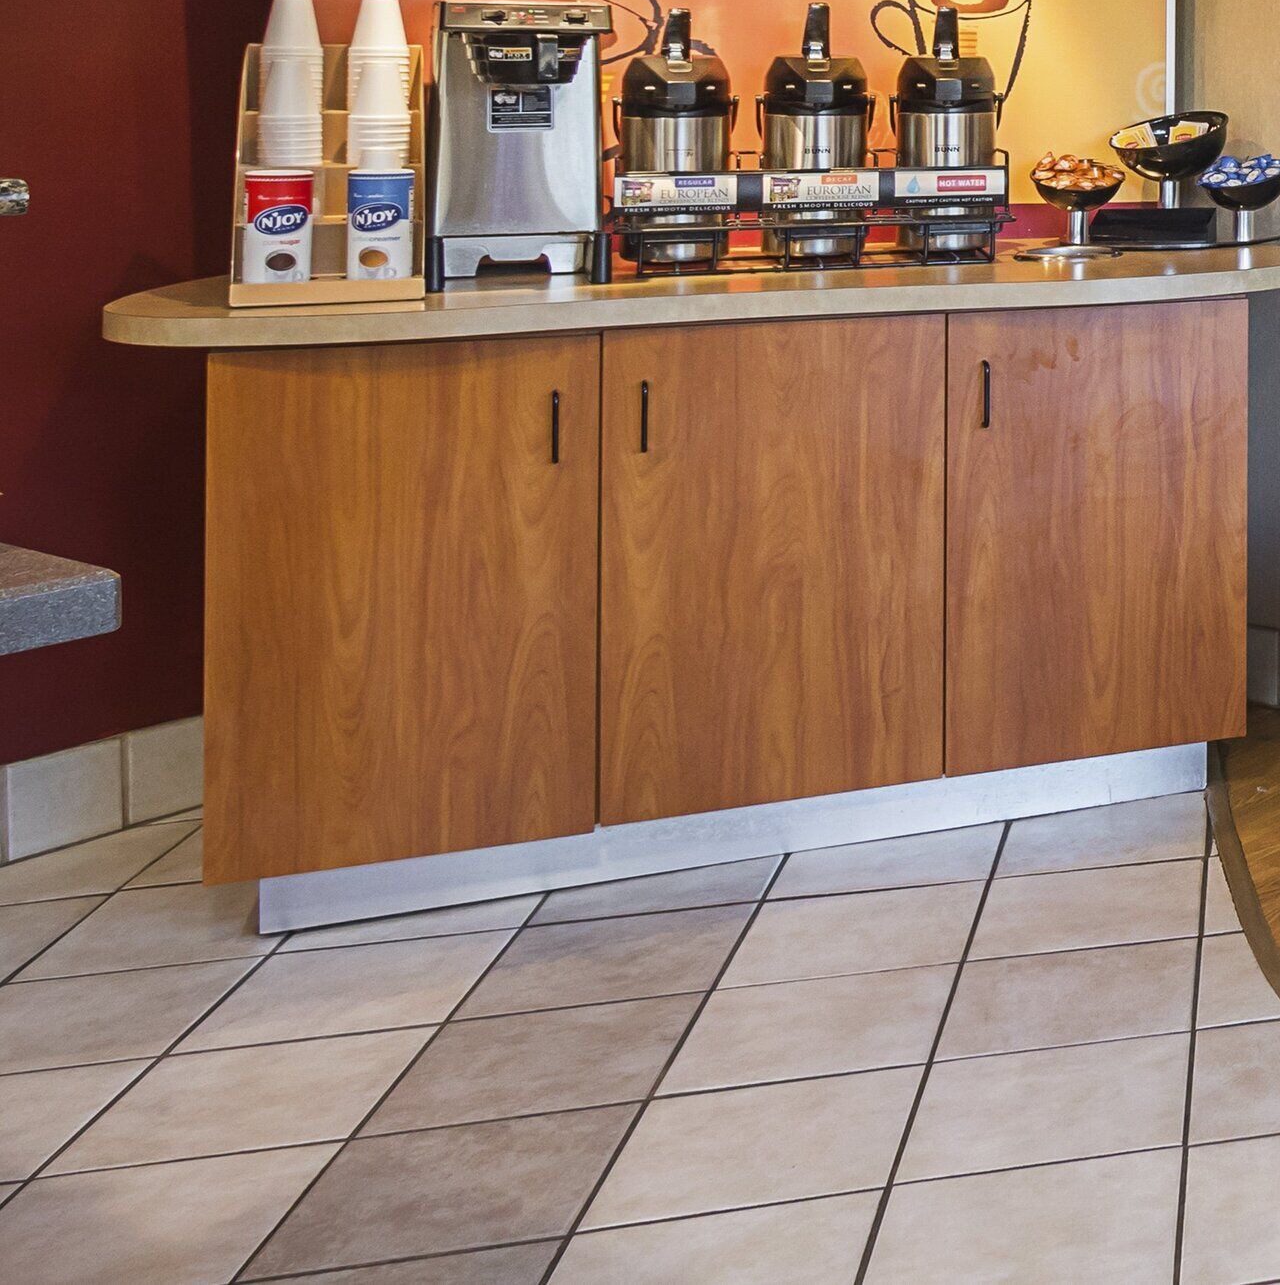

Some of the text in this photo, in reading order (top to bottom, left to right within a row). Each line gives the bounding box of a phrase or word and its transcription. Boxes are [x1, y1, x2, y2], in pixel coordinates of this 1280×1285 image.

[677, 178, 713, 186] REGULAR
[939, 179, 986, 187] HOT WATER
[660, 188, 729, 200] EUROPEAN
[807, 185, 872, 196] EUROPEAN
